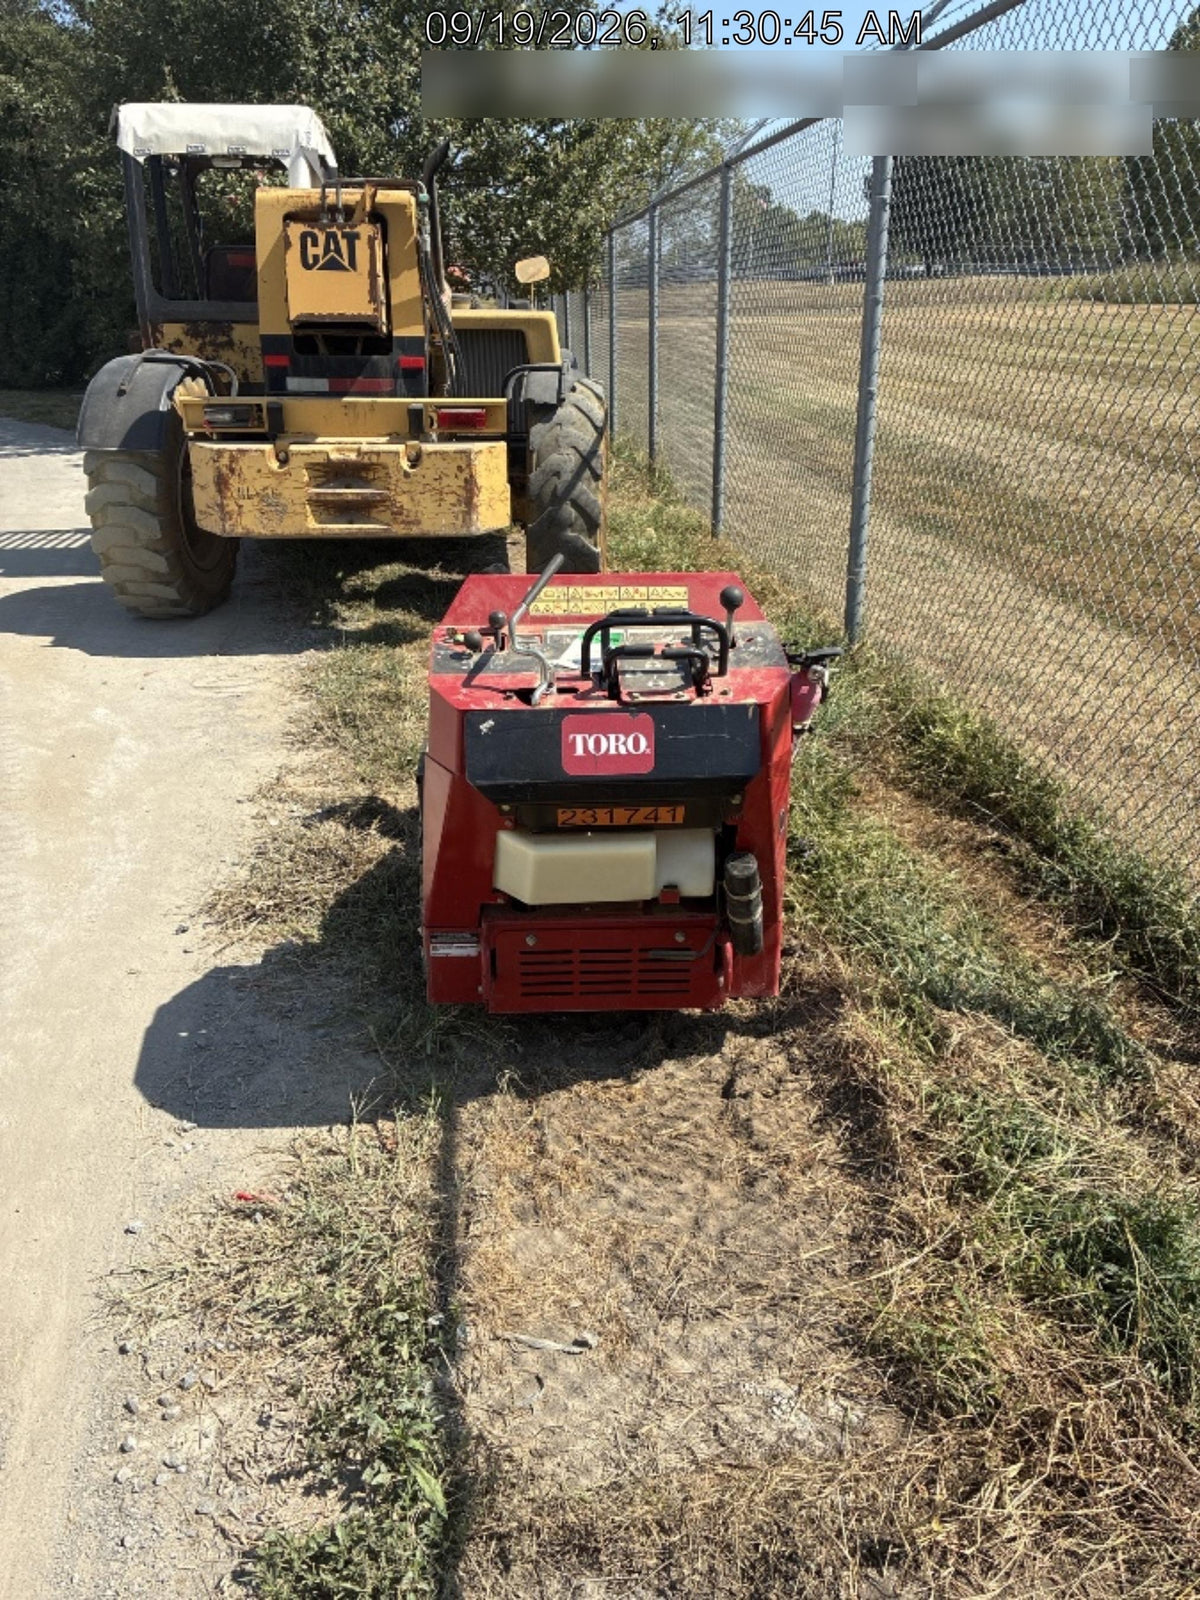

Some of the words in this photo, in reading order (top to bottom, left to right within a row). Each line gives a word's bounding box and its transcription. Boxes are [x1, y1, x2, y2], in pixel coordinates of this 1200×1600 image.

[300, 230, 360, 272] CAT
[568, 732, 648, 756] TORO
[560, 806, 679, 826] 231741
